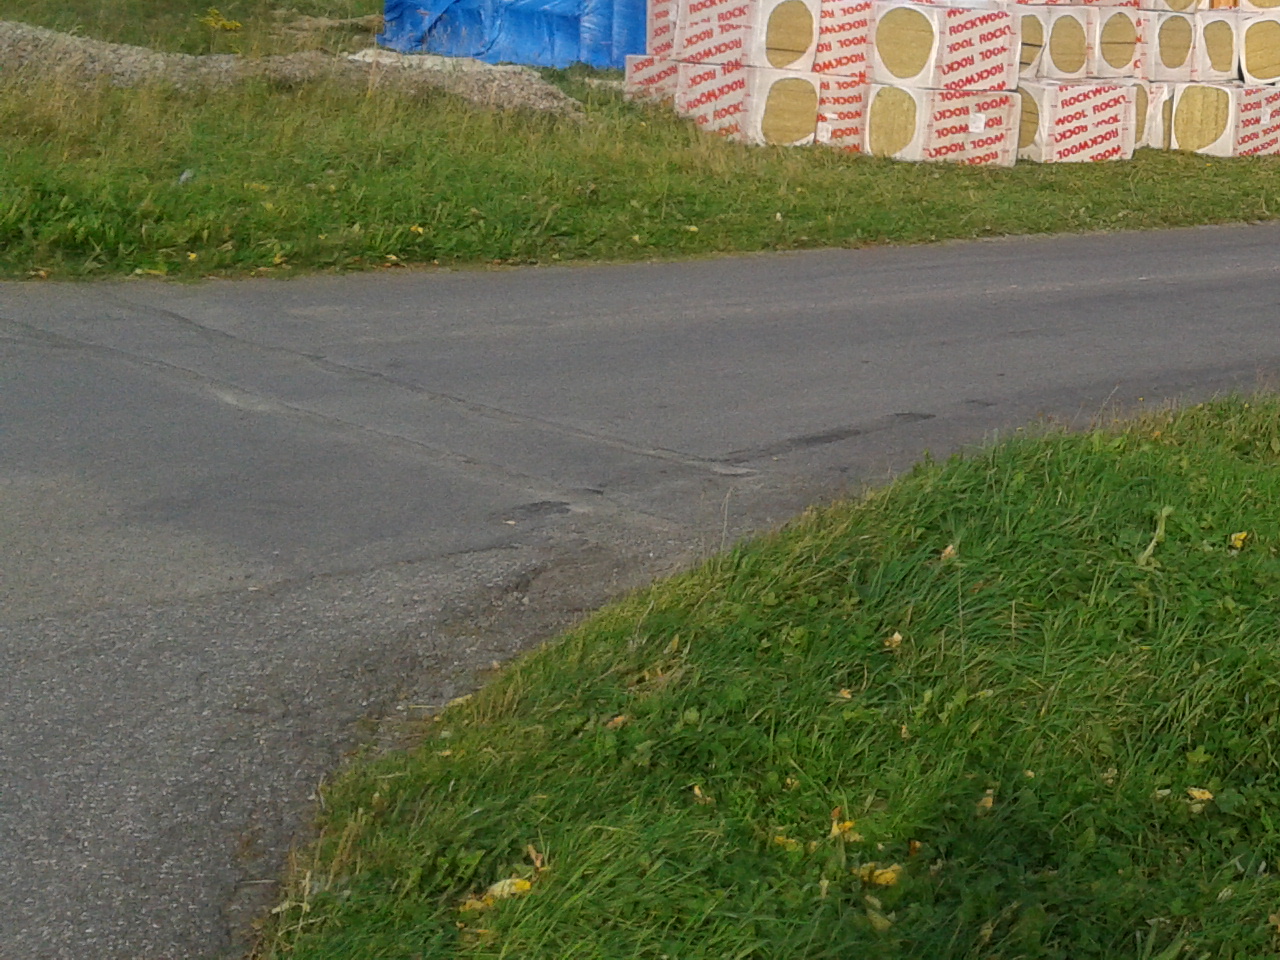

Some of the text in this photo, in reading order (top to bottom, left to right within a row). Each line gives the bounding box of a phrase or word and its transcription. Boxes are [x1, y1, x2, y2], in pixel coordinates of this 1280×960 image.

[949, 11, 1010, 36] ROCKWOOL
[944, 63, 1004, 90] ROCKWOOL
[933, 95, 1010, 121] ROCK WOOL
[1055, 95, 1126, 126] WOOL ROCK
[935, 123, 970, 139] WOOL
[1055, 125, 1088, 143] ROCK
[1056, 128, 1119, 159] ROCKWOOL
[929, 133, 1005, 158] ROCK WOOL
